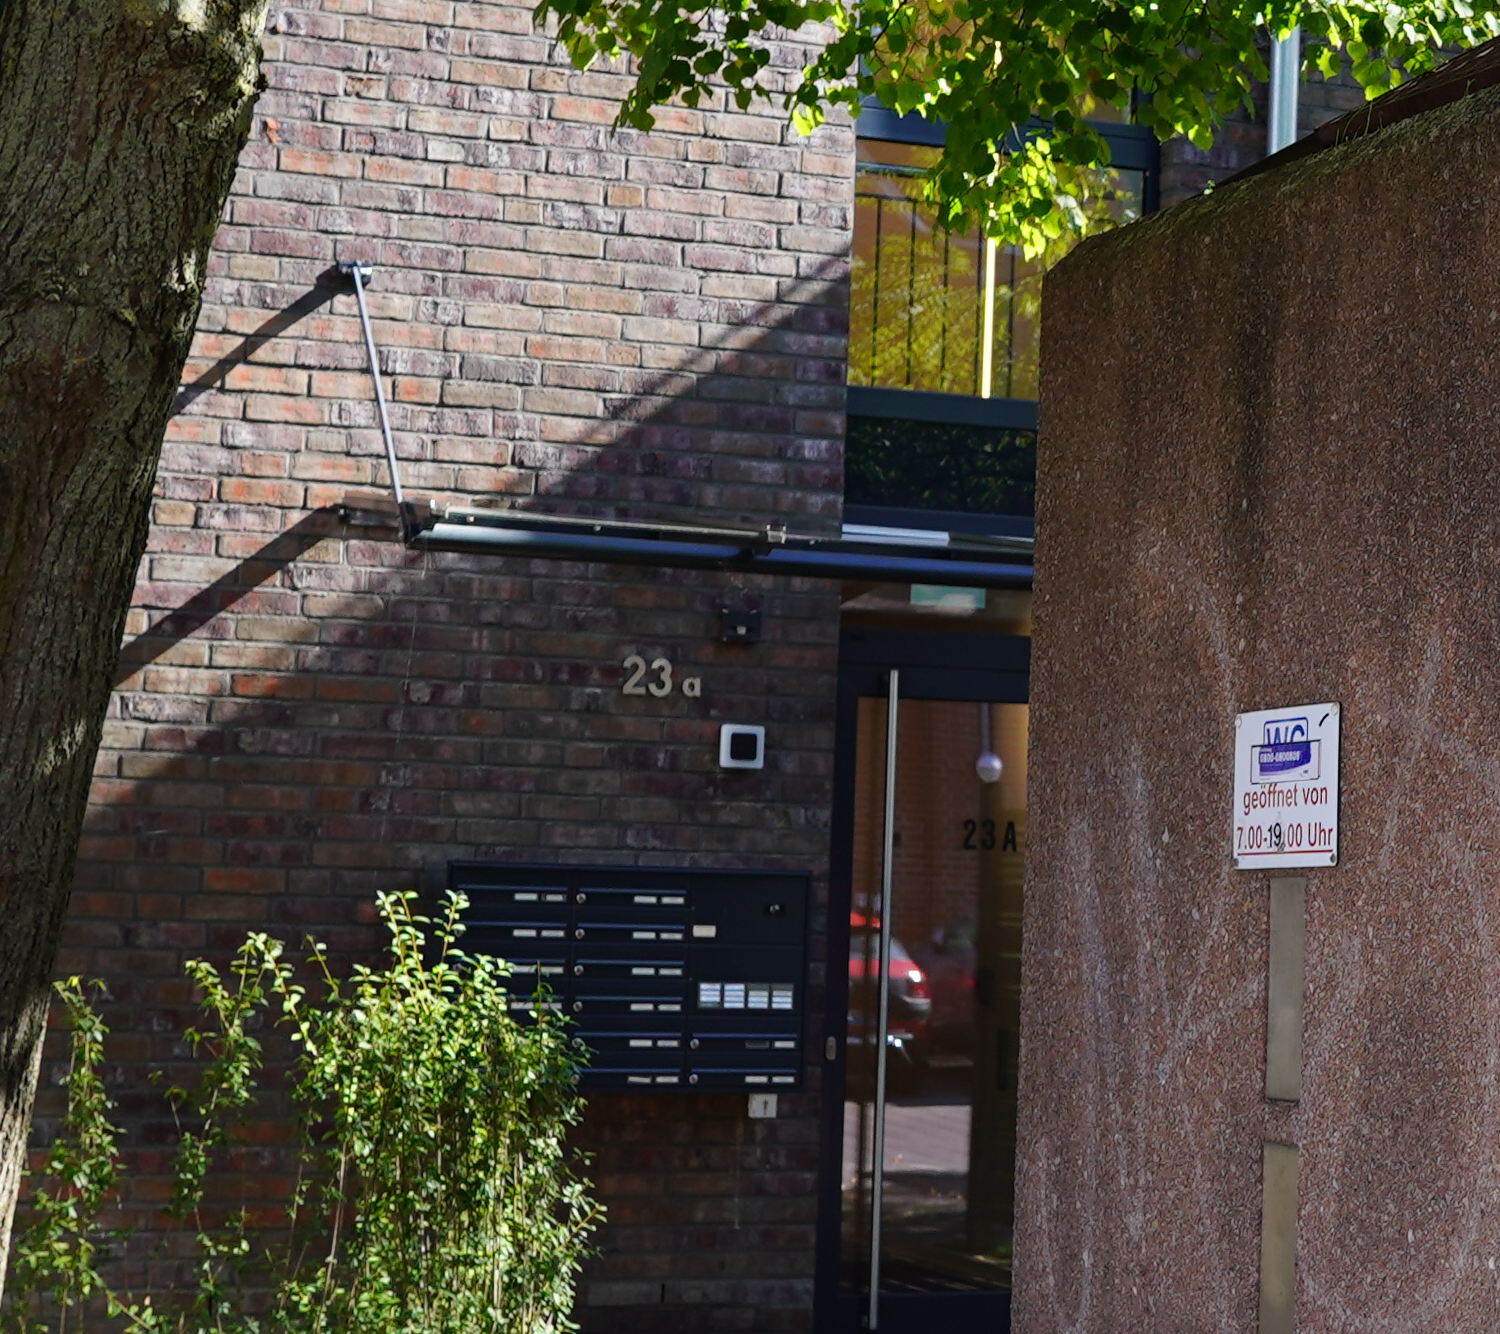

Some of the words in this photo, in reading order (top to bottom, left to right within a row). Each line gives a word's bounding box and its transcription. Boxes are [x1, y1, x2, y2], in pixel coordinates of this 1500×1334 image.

[1243, 782, 1298, 816] geöffnet
[1302, 786, 1328, 806] von
[1308, 821, 1334, 847] Uhr
